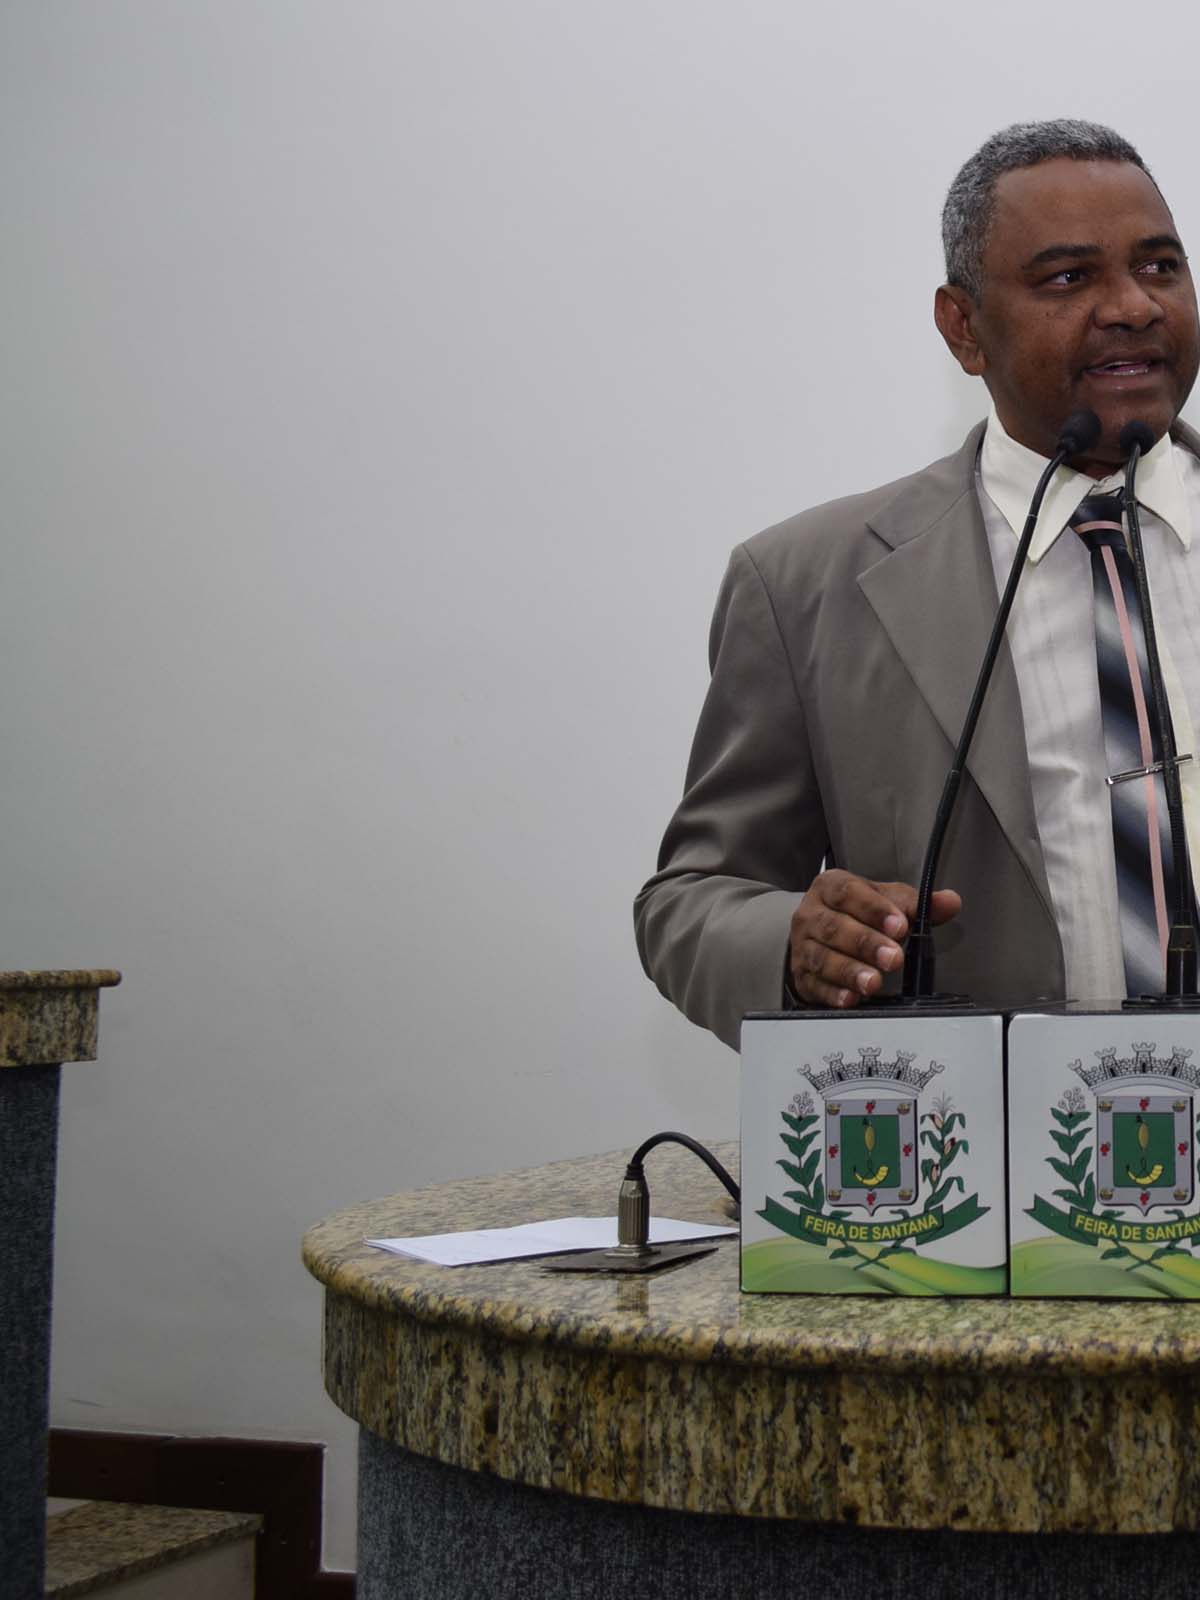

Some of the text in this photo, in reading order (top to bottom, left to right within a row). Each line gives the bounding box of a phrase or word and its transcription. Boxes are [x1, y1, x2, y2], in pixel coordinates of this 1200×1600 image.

[804, 1214, 938, 1240] FEIRA DE SANTANA
[1075, 1215, 1118, 1238] FEIRA
[1121, 1226, 1142, 1241] DE
